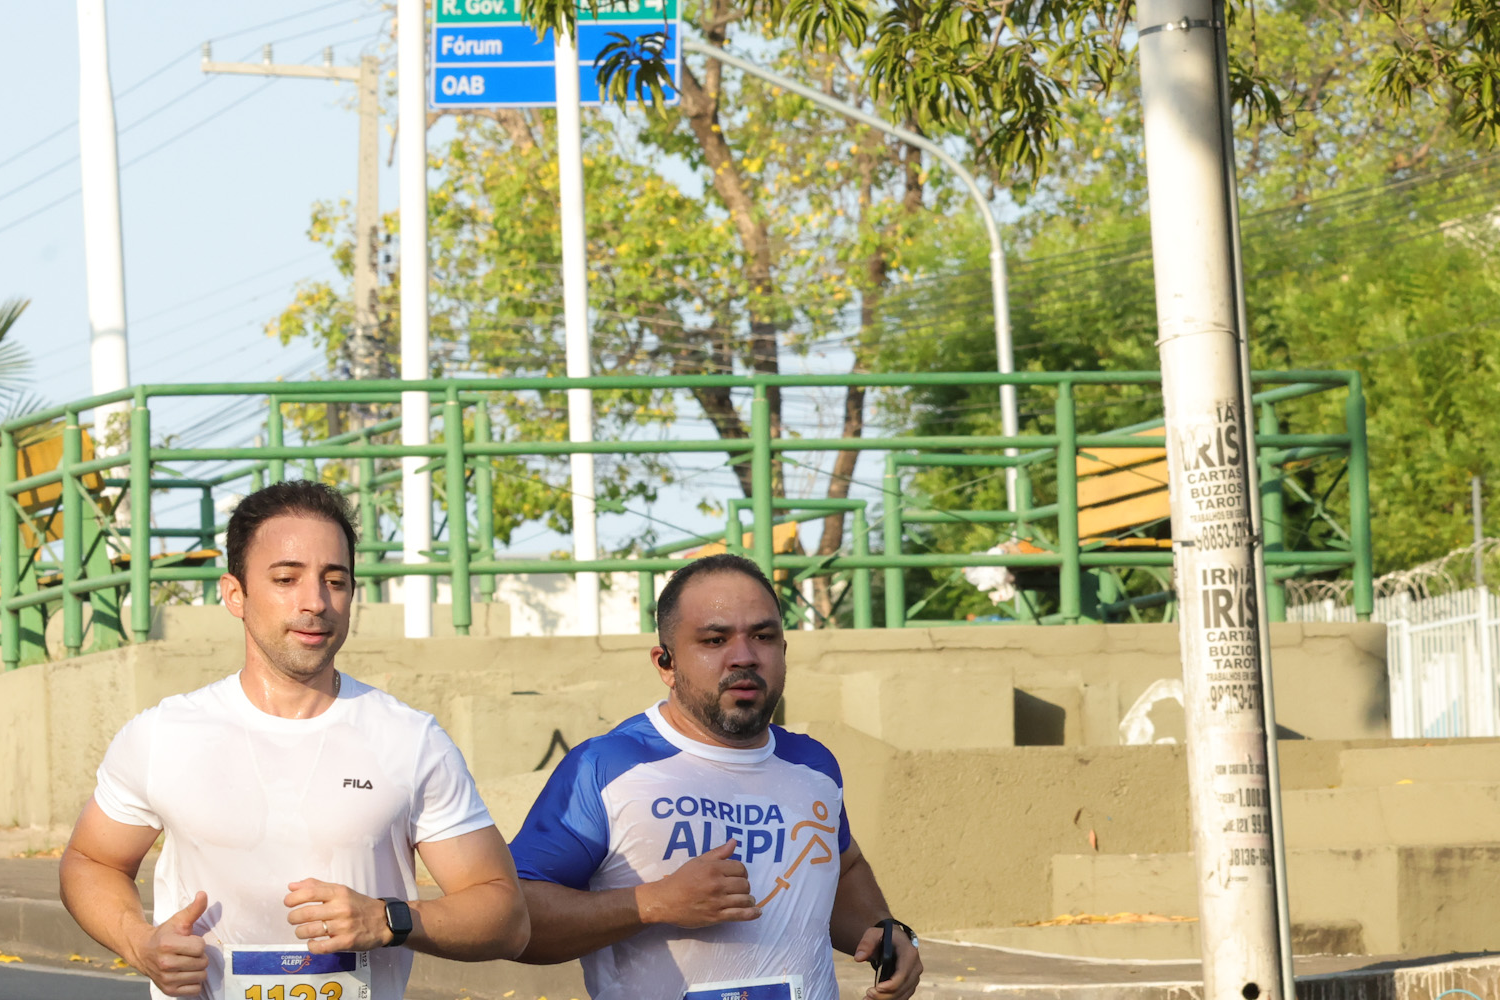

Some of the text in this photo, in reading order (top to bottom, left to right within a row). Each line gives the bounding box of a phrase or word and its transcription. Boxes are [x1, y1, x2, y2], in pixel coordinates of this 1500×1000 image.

[442, 0, 462, 15] R.
[465, 0, 508, 15] Gov.
[441, 34, 503, 56] Fórum
[441, 75, 485, 96] OAB
[1187, 468, 1242, 484] CARTAS
[1195, 496, 1242, 511] TAROT
[343, 779, 373, 789] FILA
[651, 796, 785, 826] CORRIDA
[662, 820, 786, 864] ALEPI
